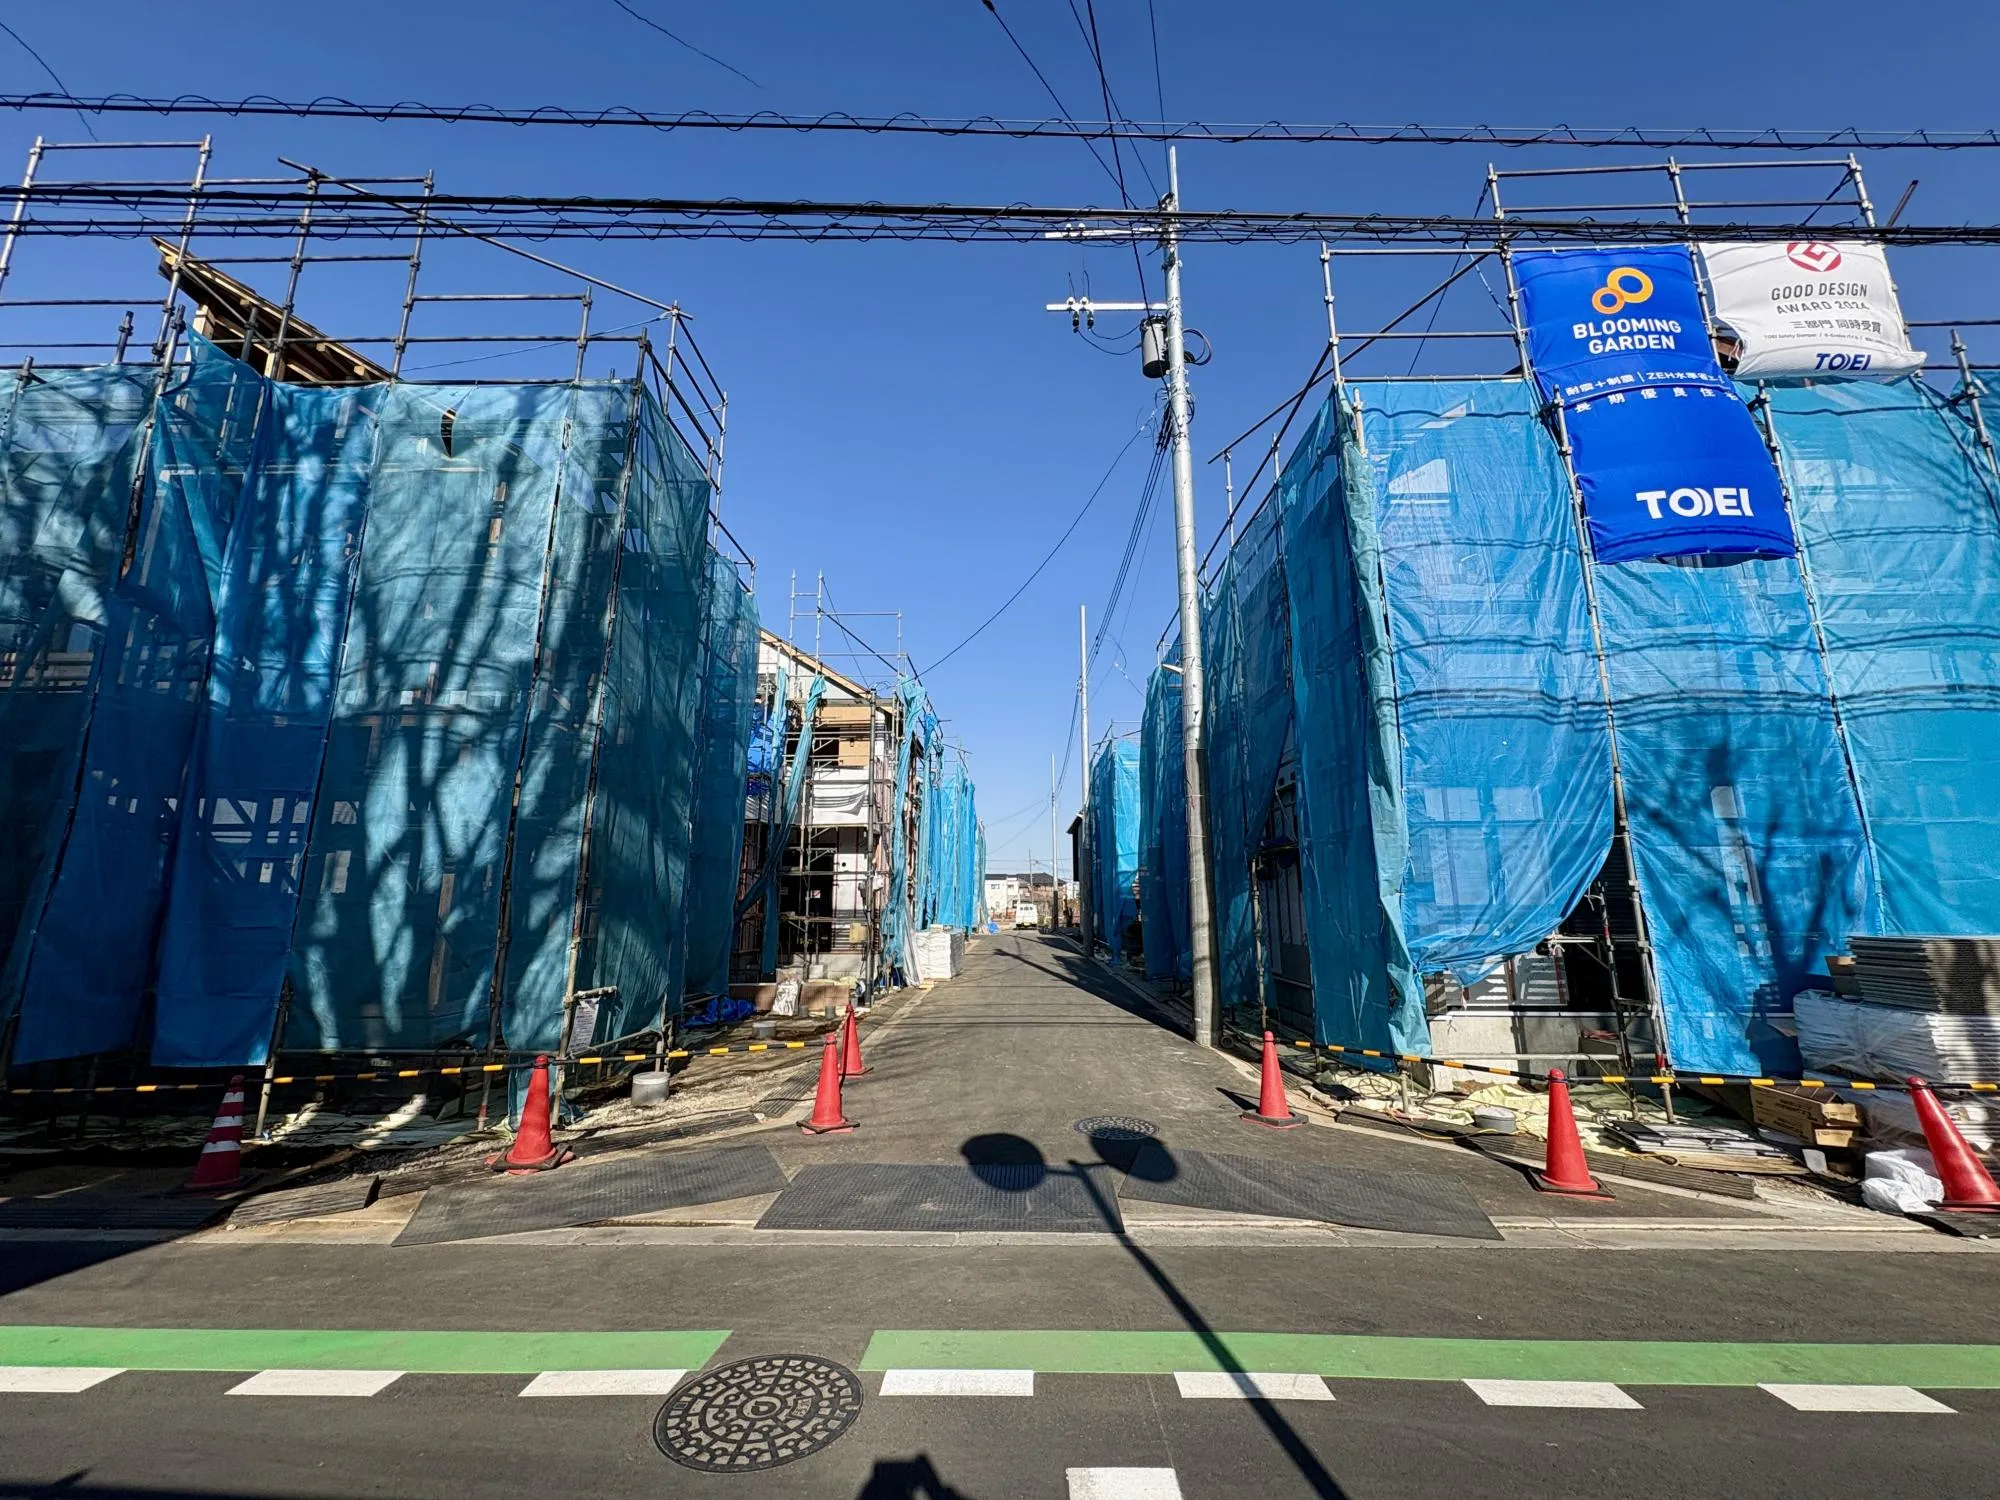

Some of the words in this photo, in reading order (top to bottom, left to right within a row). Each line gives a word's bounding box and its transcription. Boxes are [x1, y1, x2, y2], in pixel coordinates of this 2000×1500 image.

[1771, 284, 1814, 301] GOOD
[1818, 282, 1868, 297] DESIGN
[1776, 301, 1832, 314] AWARD
[1833, 300, 1870, 311] 2024
[1572, 318, 1682, 339] BLOOMING
[1789, 319, 1834, 329] 三部門
[1835, 319, 1881, 335] 同時受賞
[1588, 334, 1676, 354] GARDEN
[1814, 353, 1871, 371] TOEI
[1635, 487, 1754, 519] TOEI
